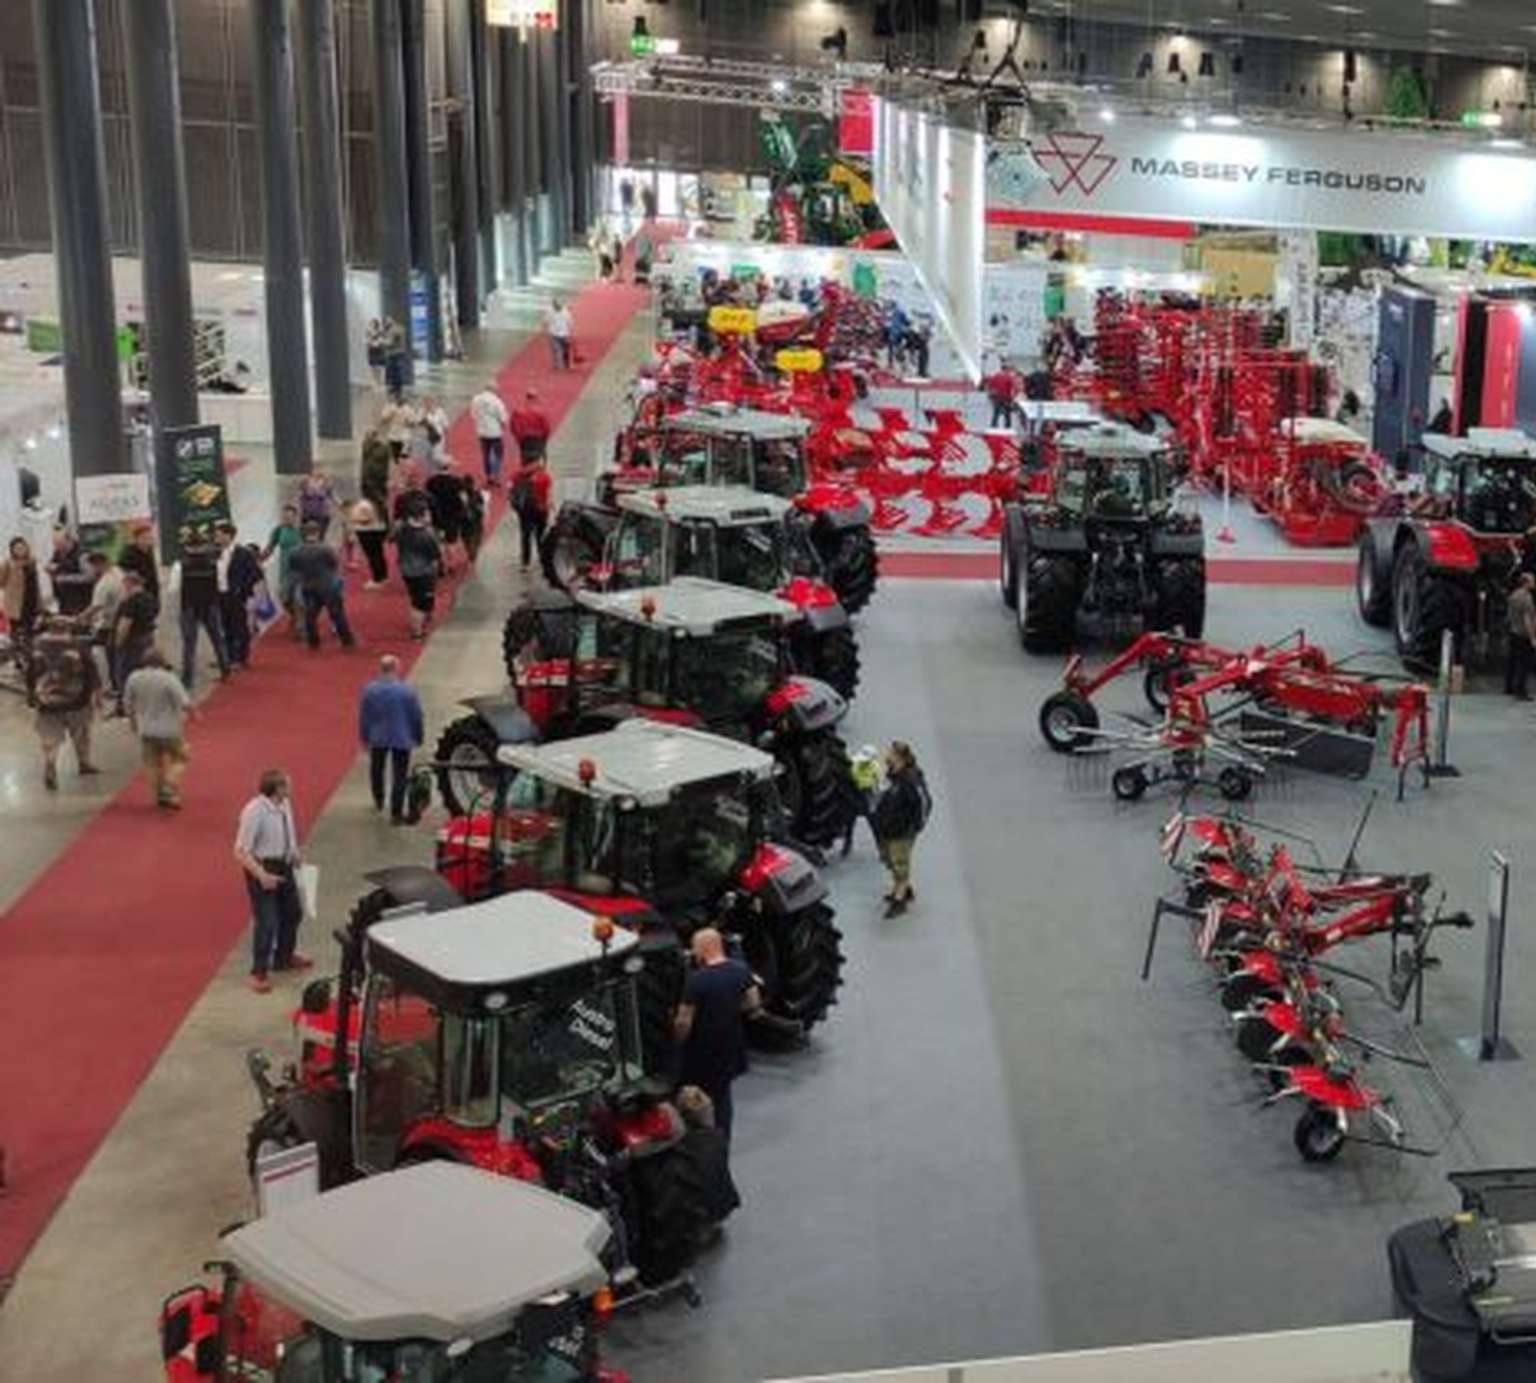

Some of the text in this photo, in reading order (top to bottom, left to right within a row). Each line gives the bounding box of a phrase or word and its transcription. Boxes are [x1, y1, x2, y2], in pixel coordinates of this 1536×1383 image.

[1131, 156, 1427, 194] MASSEY FERGUSON
[568, 998, 616, 1032] Austro
[568, 1017, 614, 1050] Diesel
